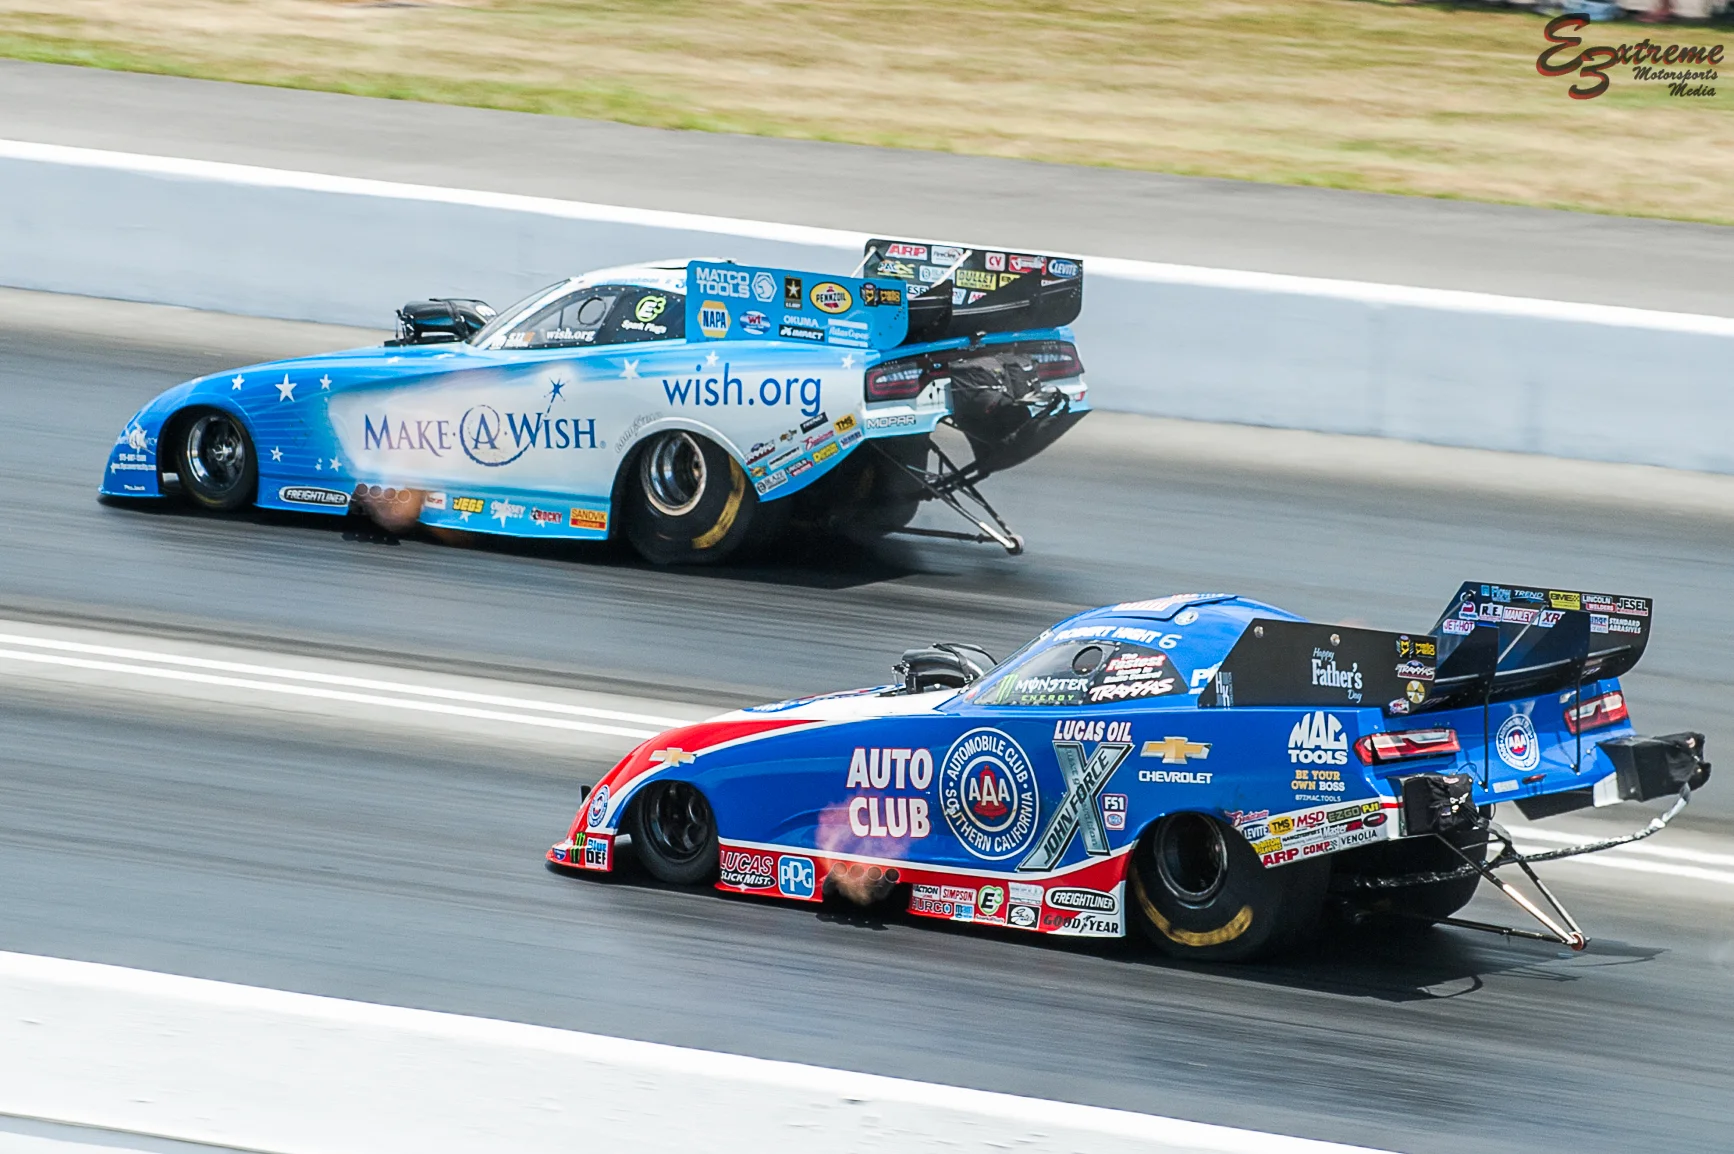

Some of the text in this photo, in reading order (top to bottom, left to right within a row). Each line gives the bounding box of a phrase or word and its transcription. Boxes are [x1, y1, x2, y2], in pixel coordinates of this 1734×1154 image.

[888, 244, 926, 256] ARP
[696, 267, 750, 284] MATCO
[1048, 259, 1078, 276] CLEVITE
[697, 282, 750, 298] TOOLS
[815, 292, 847, 303] PENNZOIL
[703, 309, 727, 329] NAPA
[783, 315, 819, 328] OKUMA
[546, 327, 596, 341] wish.org
[792, 329, 823, 339] IMPACT
[662, 362, 822, 417] wish.org
[867, 415, 915, 430] MOPAR
[364, 412, 599, 457] MAKE A WISH
[285, 489, 347, 505] FREIGHTLINER
[453, 497, 484, 513] JEGS
[571, 508, 607, 521] SANDVIK
[1513, 590, 1544, 598] TREND
[1582, 595, 1612, 604] LINCOLN
[1617, 598, 1648, 611] JESEL
[1505, 608, 1534, 622] MANLEY
[1609, 617, 1641, 627] STANDARD
[1158, 634, 1183, 649] 6
[1313, 647, 1335, 662] Happy
[1311, 658, 1363, 690] Father's
[1015, 676, 1089, 693] MONSTER
[1088, 678, 1176, 702] TRAXXAS
[1021, 694, 1075, 702] ENERGY
[1347, 689, 1363, 704] Day
[1053, 720, 1134, 742] LUCAS OIL
[1288, 711, 1349, 750] MAC
[947, 736, 1029, 784] AUTOMOBILE CLUB
[1288, 749, 1348, 765] TOOLS
[846, 747, 933, 791] AUTO
[1139, 770, 1213, 784] CHEVROLET
[1295, 770, 1340, 781] BE YOUR
[968, 775, 1011, 806] AAA
[1291, 780, 1346, 792] OWN BOSS
[1043, 750, 1110, 866] JOHN FORCE
[1104, 796, 1124, 811] FS1
[1362, 802, 1380, 814] PJ1
[849, 796, 931, 839] CLUB
[994, 791, 1033, 853] CALIFORNIA
[1271, 818, 1290, 830] TMS
[1296, 811, 1325, 827] MSD
[1341, 829, 1377, 845] VENOLIA
[588, 839, 607, 852] Blue
[1302, 840, 1331, 856] COMP
[721, 851, 774, 875] LUCAS
[1262, 848, 1299, 867] ARP
[780, 861, 813, 892] PPG
[943, 889, 974, 901] SIMPSON
[1053, 891, 1114, 909] FREIGHTLINER
